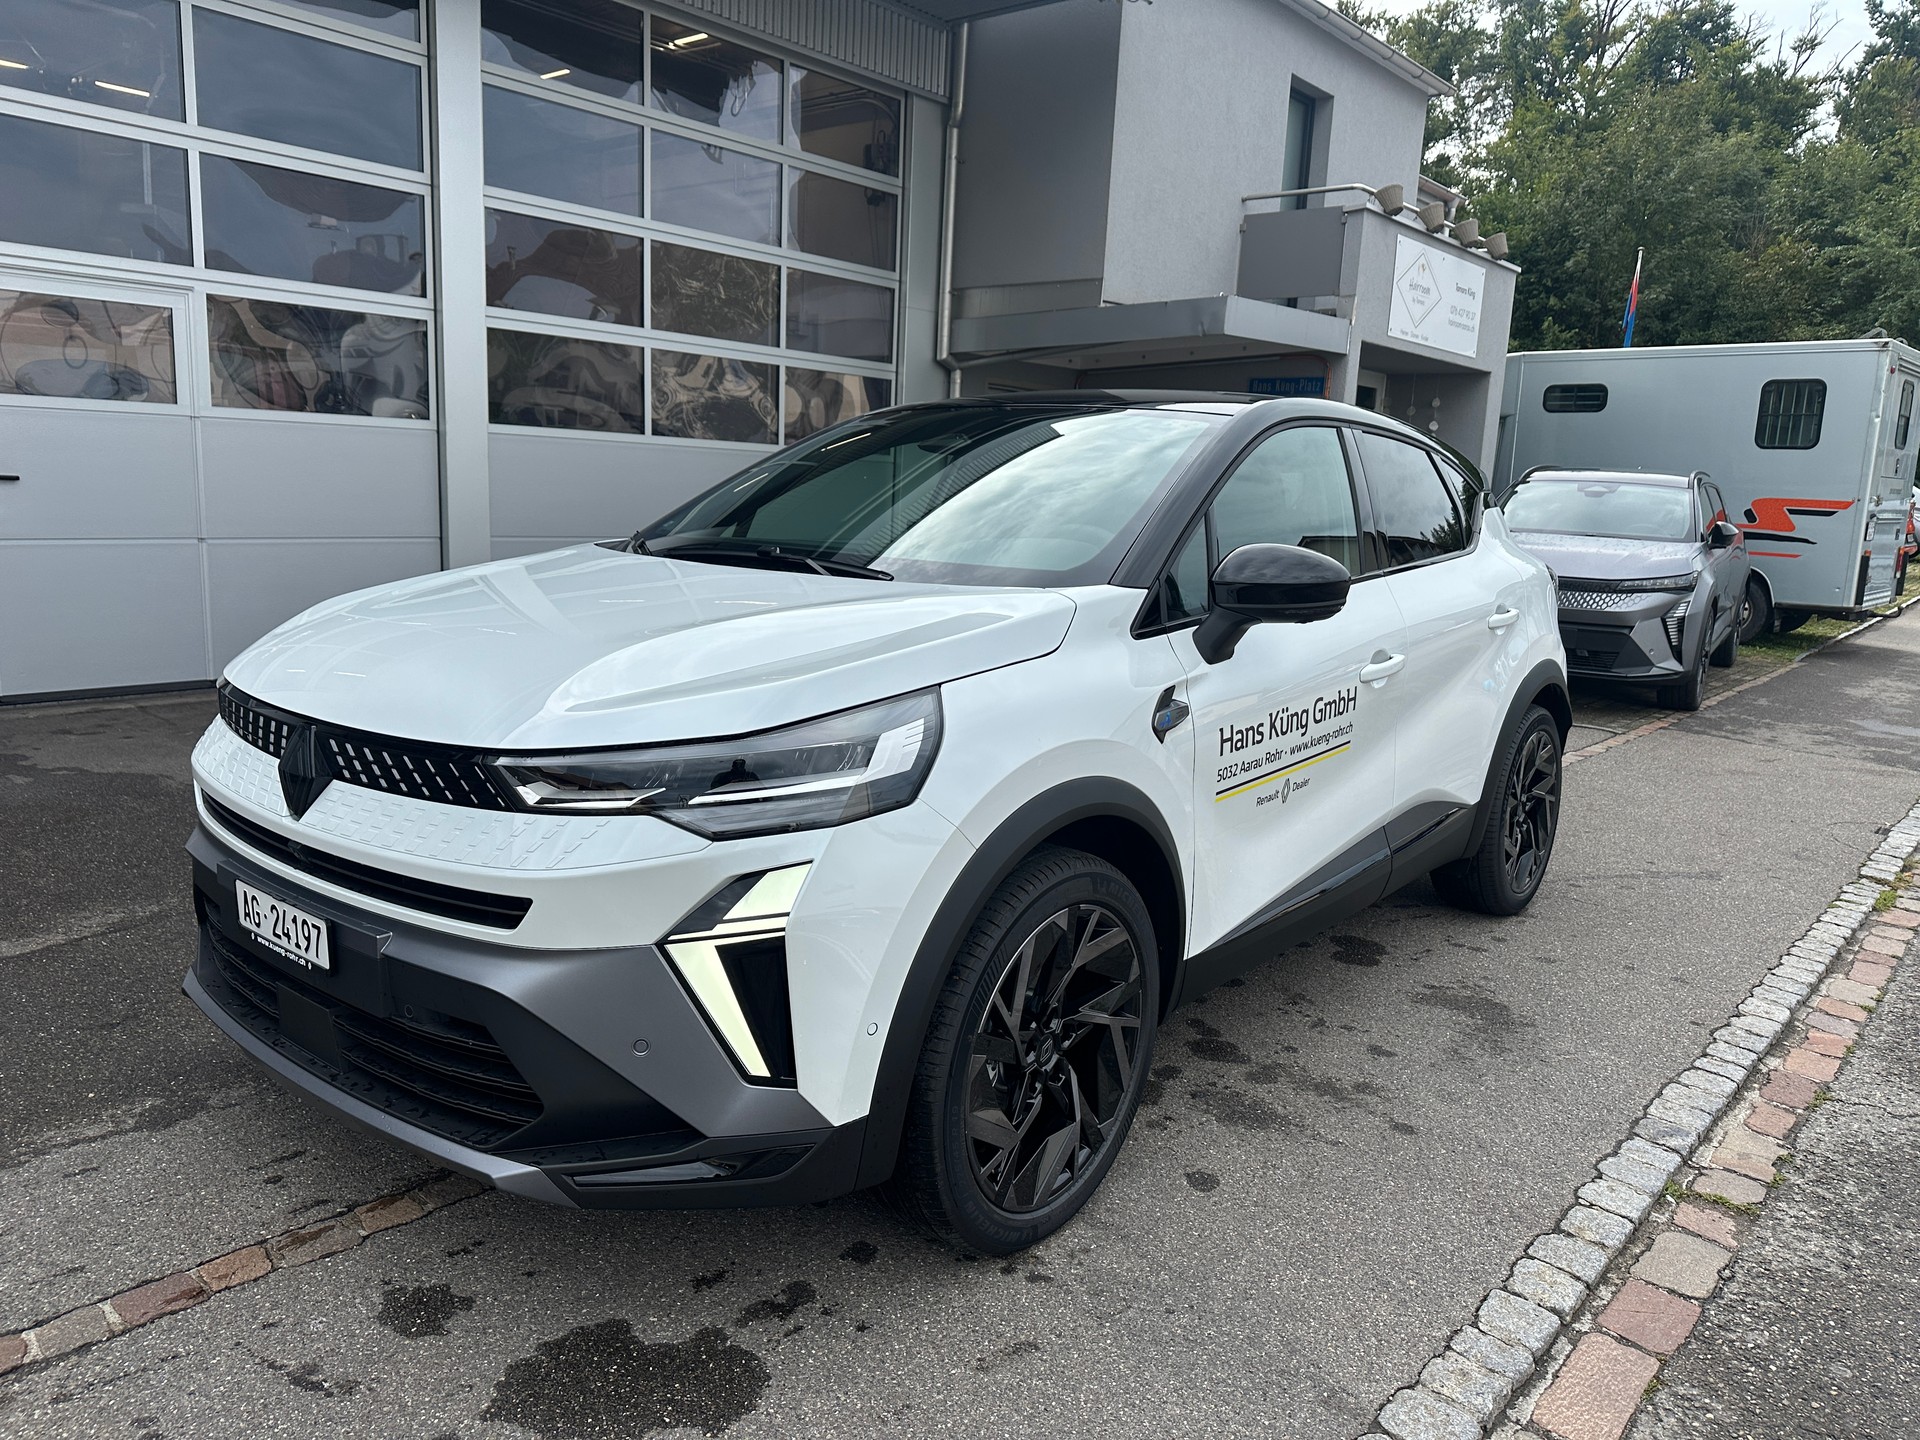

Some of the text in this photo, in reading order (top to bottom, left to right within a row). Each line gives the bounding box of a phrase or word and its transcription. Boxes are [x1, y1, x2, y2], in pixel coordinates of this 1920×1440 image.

[1217, 762, 1239, 783] 5032
[1239, 757, 1263, 775] Aarau
[1265, 748, 1283, 766] Rohr
[1289, 721, 1353, 756] www.kueng-rohr.ch
[1219, 686, 1357, 757] Hans Küng GmbH
[1256, 777, 1310, 807] Renault Dealer
